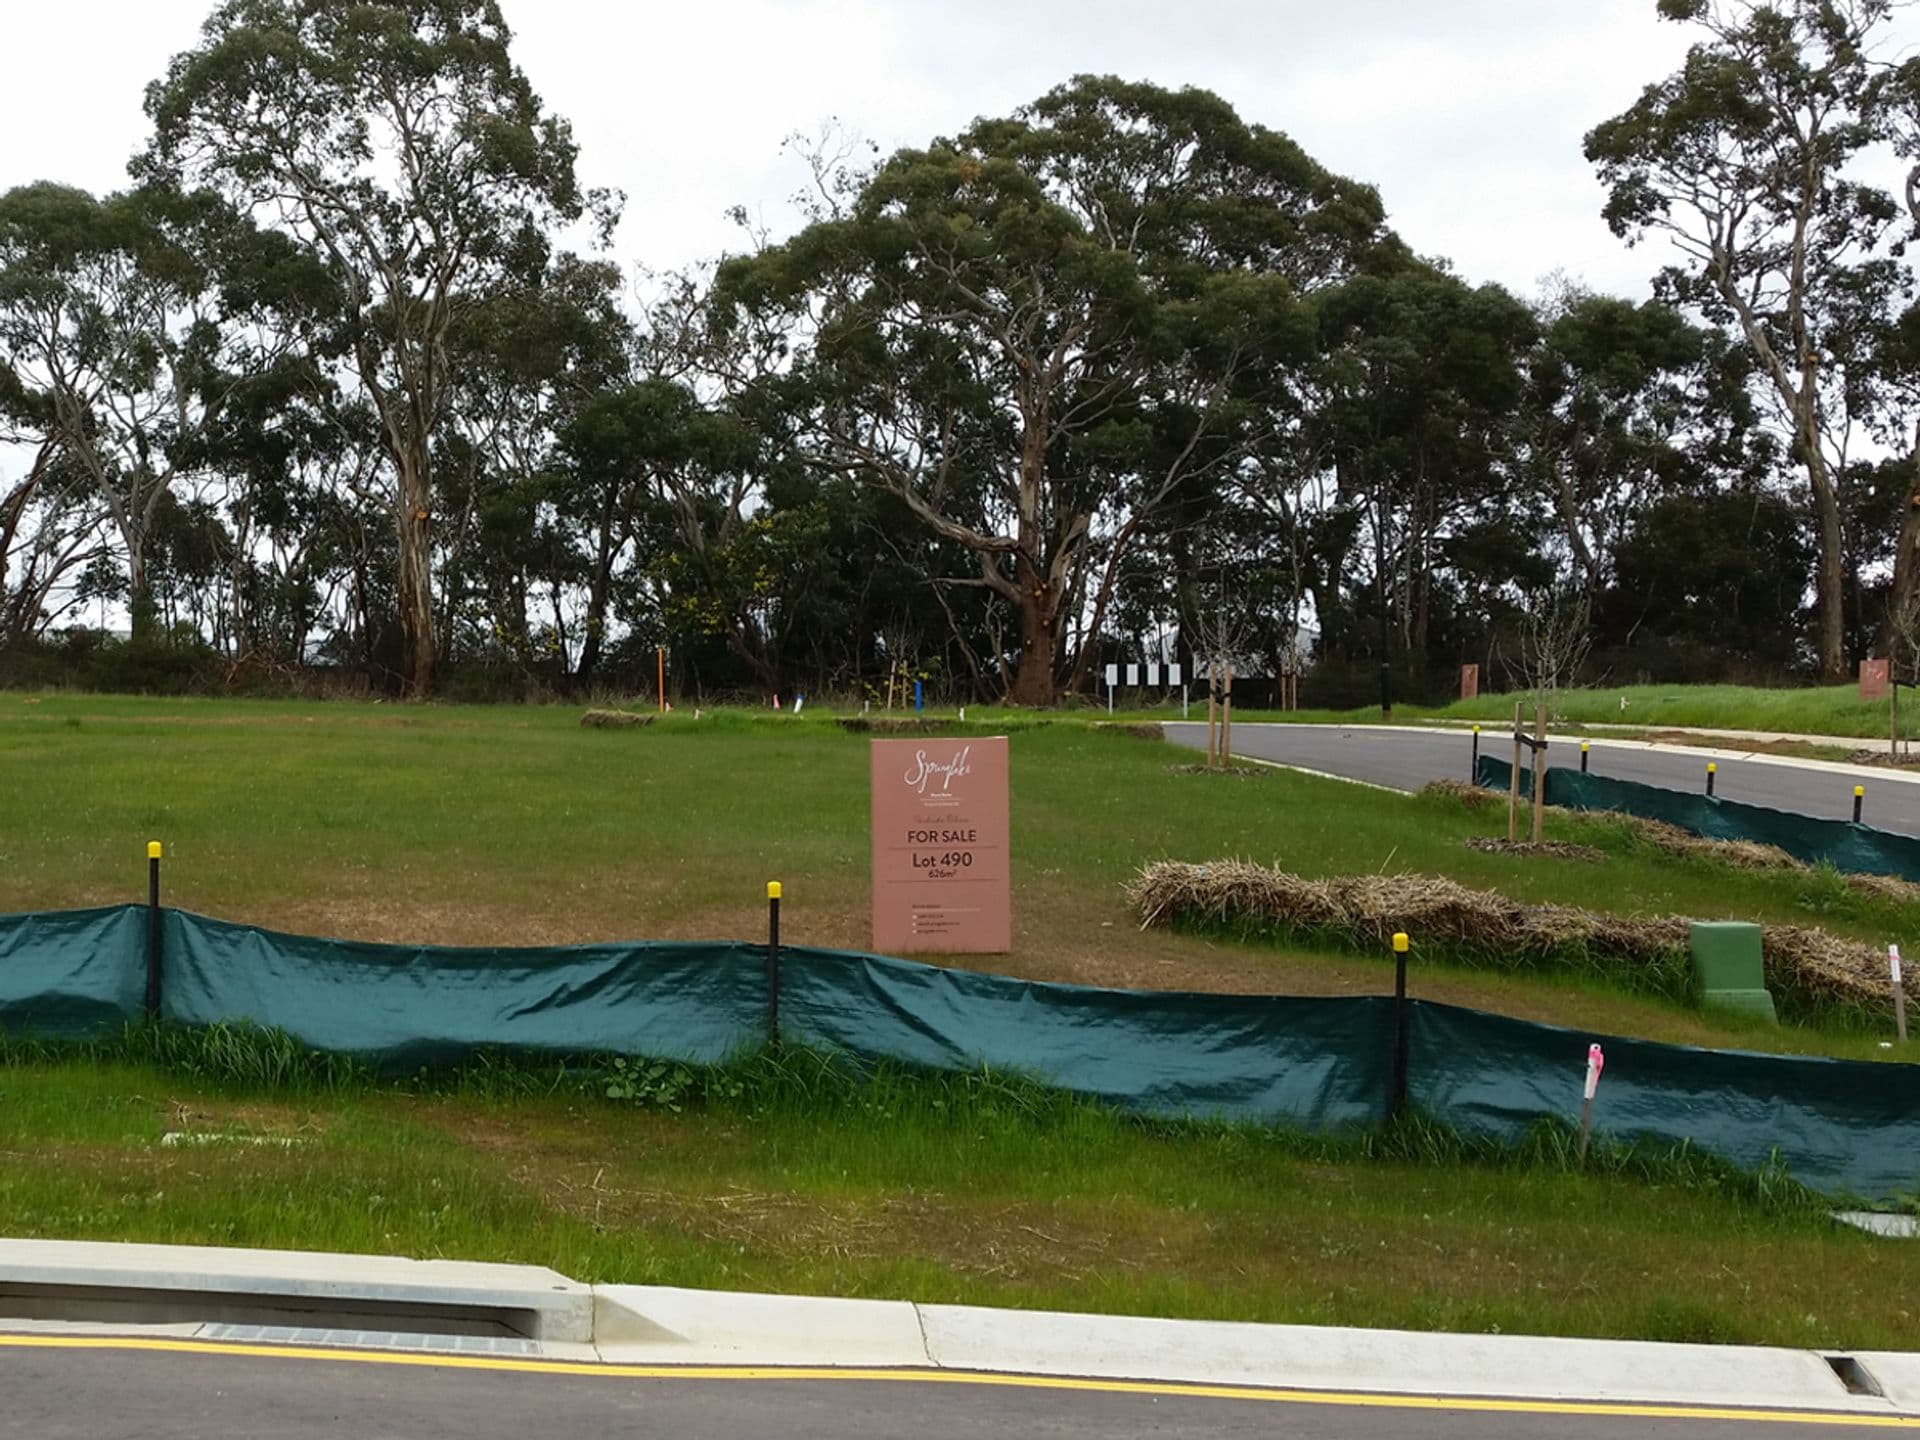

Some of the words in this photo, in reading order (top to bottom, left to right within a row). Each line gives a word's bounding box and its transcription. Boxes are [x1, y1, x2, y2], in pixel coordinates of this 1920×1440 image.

[908, 830, 938, 843] FOR
[942, 829, 976, 843] SALE
[913, 853, 936, 867] Lot
[940, 851, 973, 867] 490
